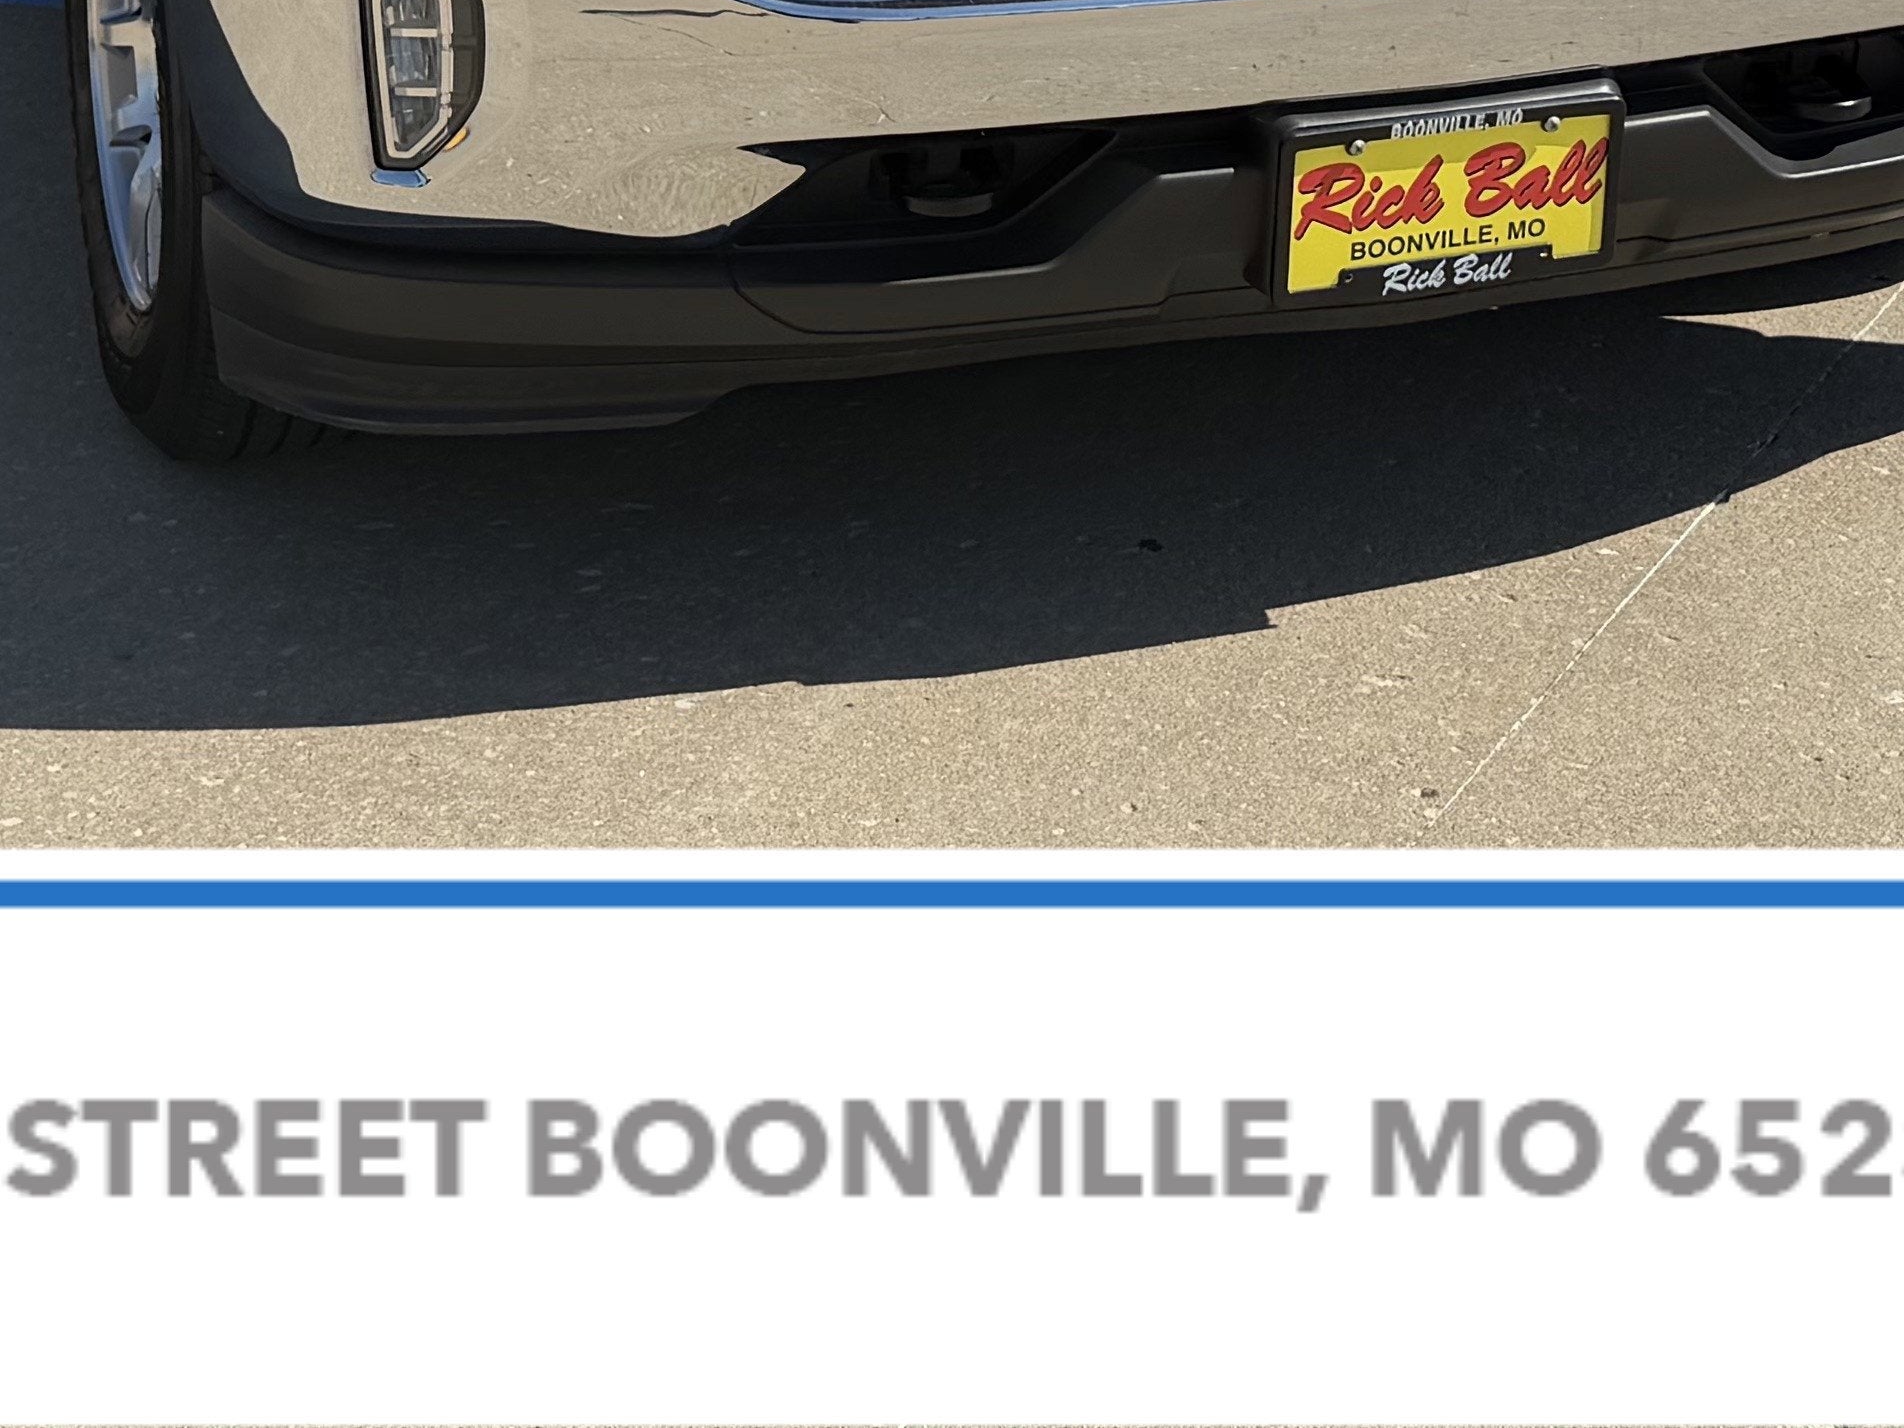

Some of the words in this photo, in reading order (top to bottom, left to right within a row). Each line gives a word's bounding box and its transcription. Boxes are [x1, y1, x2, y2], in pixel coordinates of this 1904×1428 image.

[1496, 108, 1523, 126] MO
[1294, 154, 1445, 241] Rick
[1464, 137, 1610, 217] Ball
[1350, 224, 1500, 262] BOONVILLE,
[1507, 218, 1546, 241] MO
[1382, 261, 1446, 295] Rick
[1454, 252, 1511, 284] Ball
